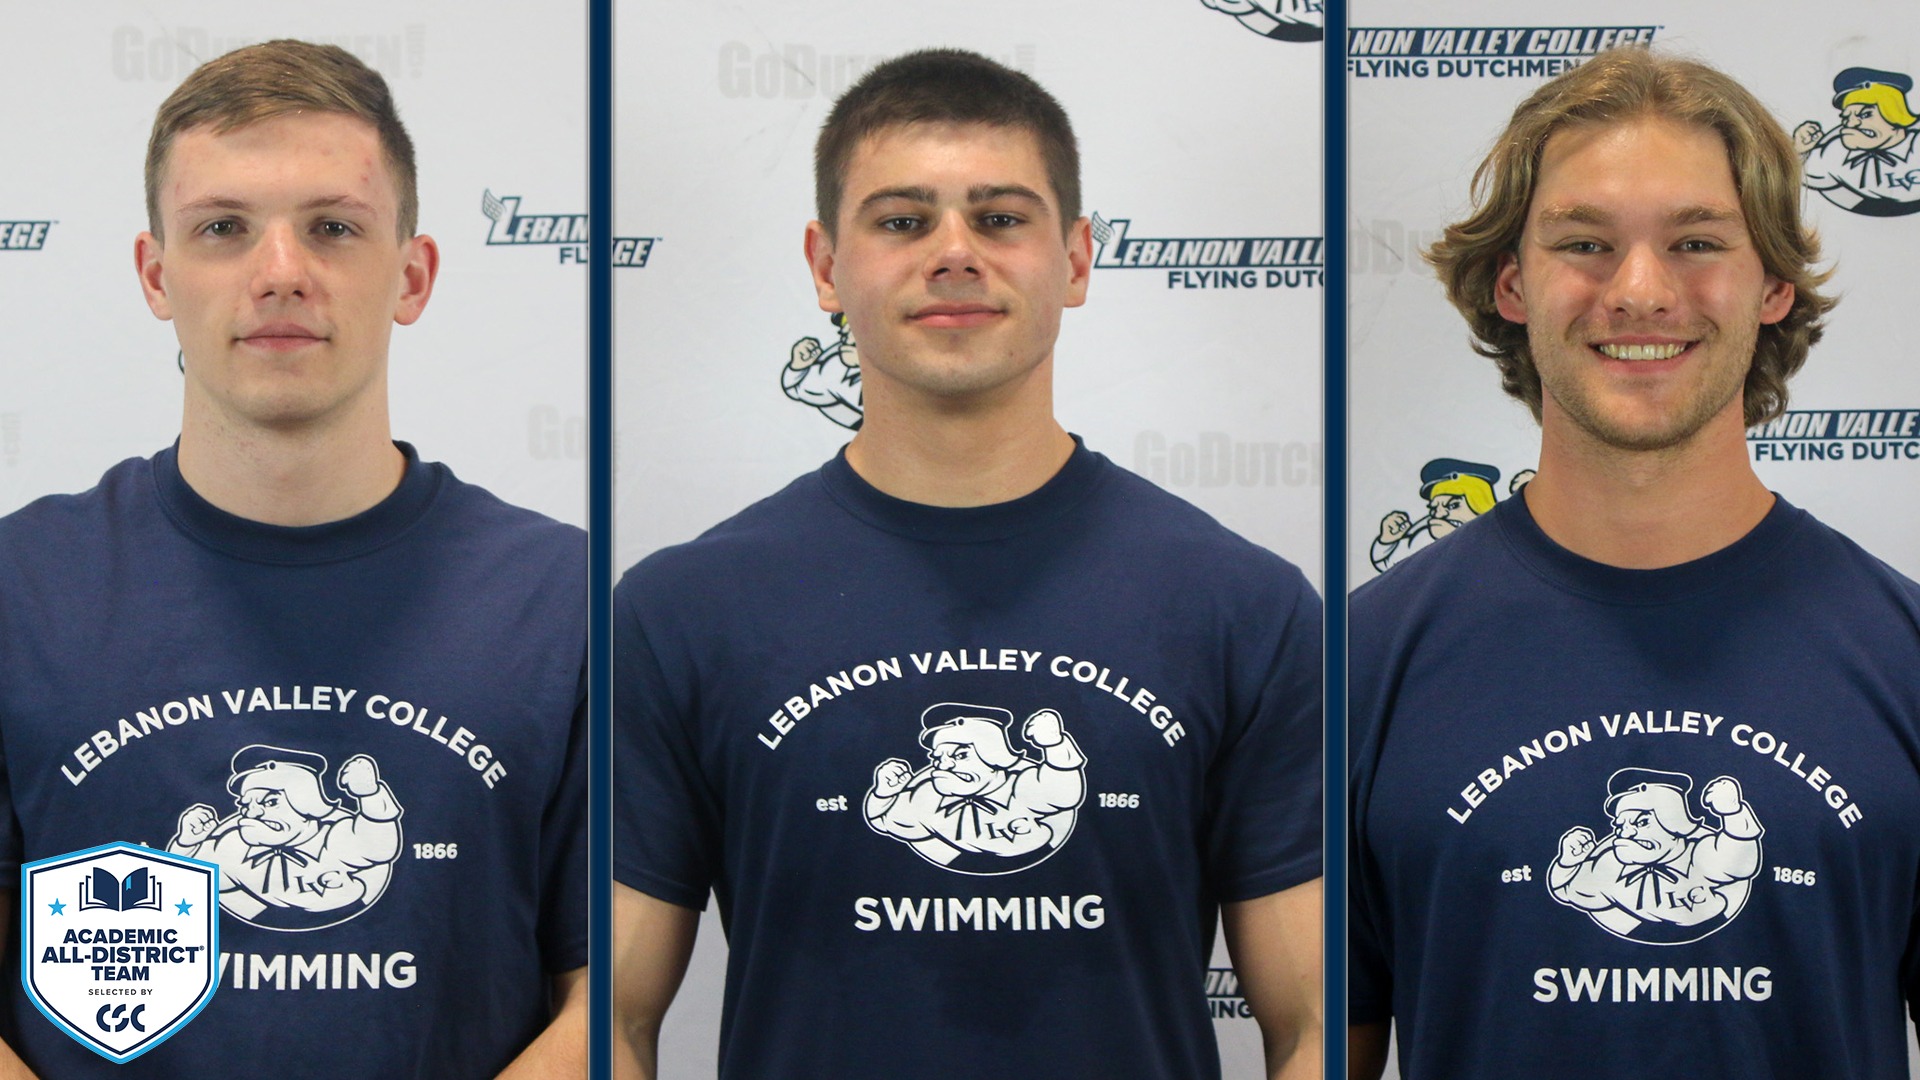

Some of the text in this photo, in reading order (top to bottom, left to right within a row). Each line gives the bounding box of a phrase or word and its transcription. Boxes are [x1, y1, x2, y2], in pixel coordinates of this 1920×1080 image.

[1421, 29, 1526, 55] VALLEY
[1526, 28, 1653, 54] COLLEGE
[560, 247, 588, 264] FL
[614, 239, 652, 265] GE
[1097, 219, 1246, 267] LEBANON
[1168, 270, 1323, 289] FLYING DUT
[1836, 411, 1920, 437] VALLE
[1755, 441, 1920, 461] FLYING DUTC
[757, 648, 1186, 751] LEBANON VALLEY COLLEGE
[60, 685, 507, 790] LEBANON VALLEY COLLEGE
[1446, 710, 1863, 829] LEBANON VALLEY COLLEGE
[815, 794, 848, 812] est
[1098, 792, 1140, 809] 1866
[985, 817, 1031, 843] LVC
[412, 842, 458, 860] 1866
[294, 870, 344, 897] LVC
[1501, 864, 1532, 884] est
[1773, 866, 1816, 887] 1866
[1665, 886, 1706, 912] LVC
[854, 894, 1105, 932] SWIMMING
[1532, 966, 1773, 1003] SWIMMING
